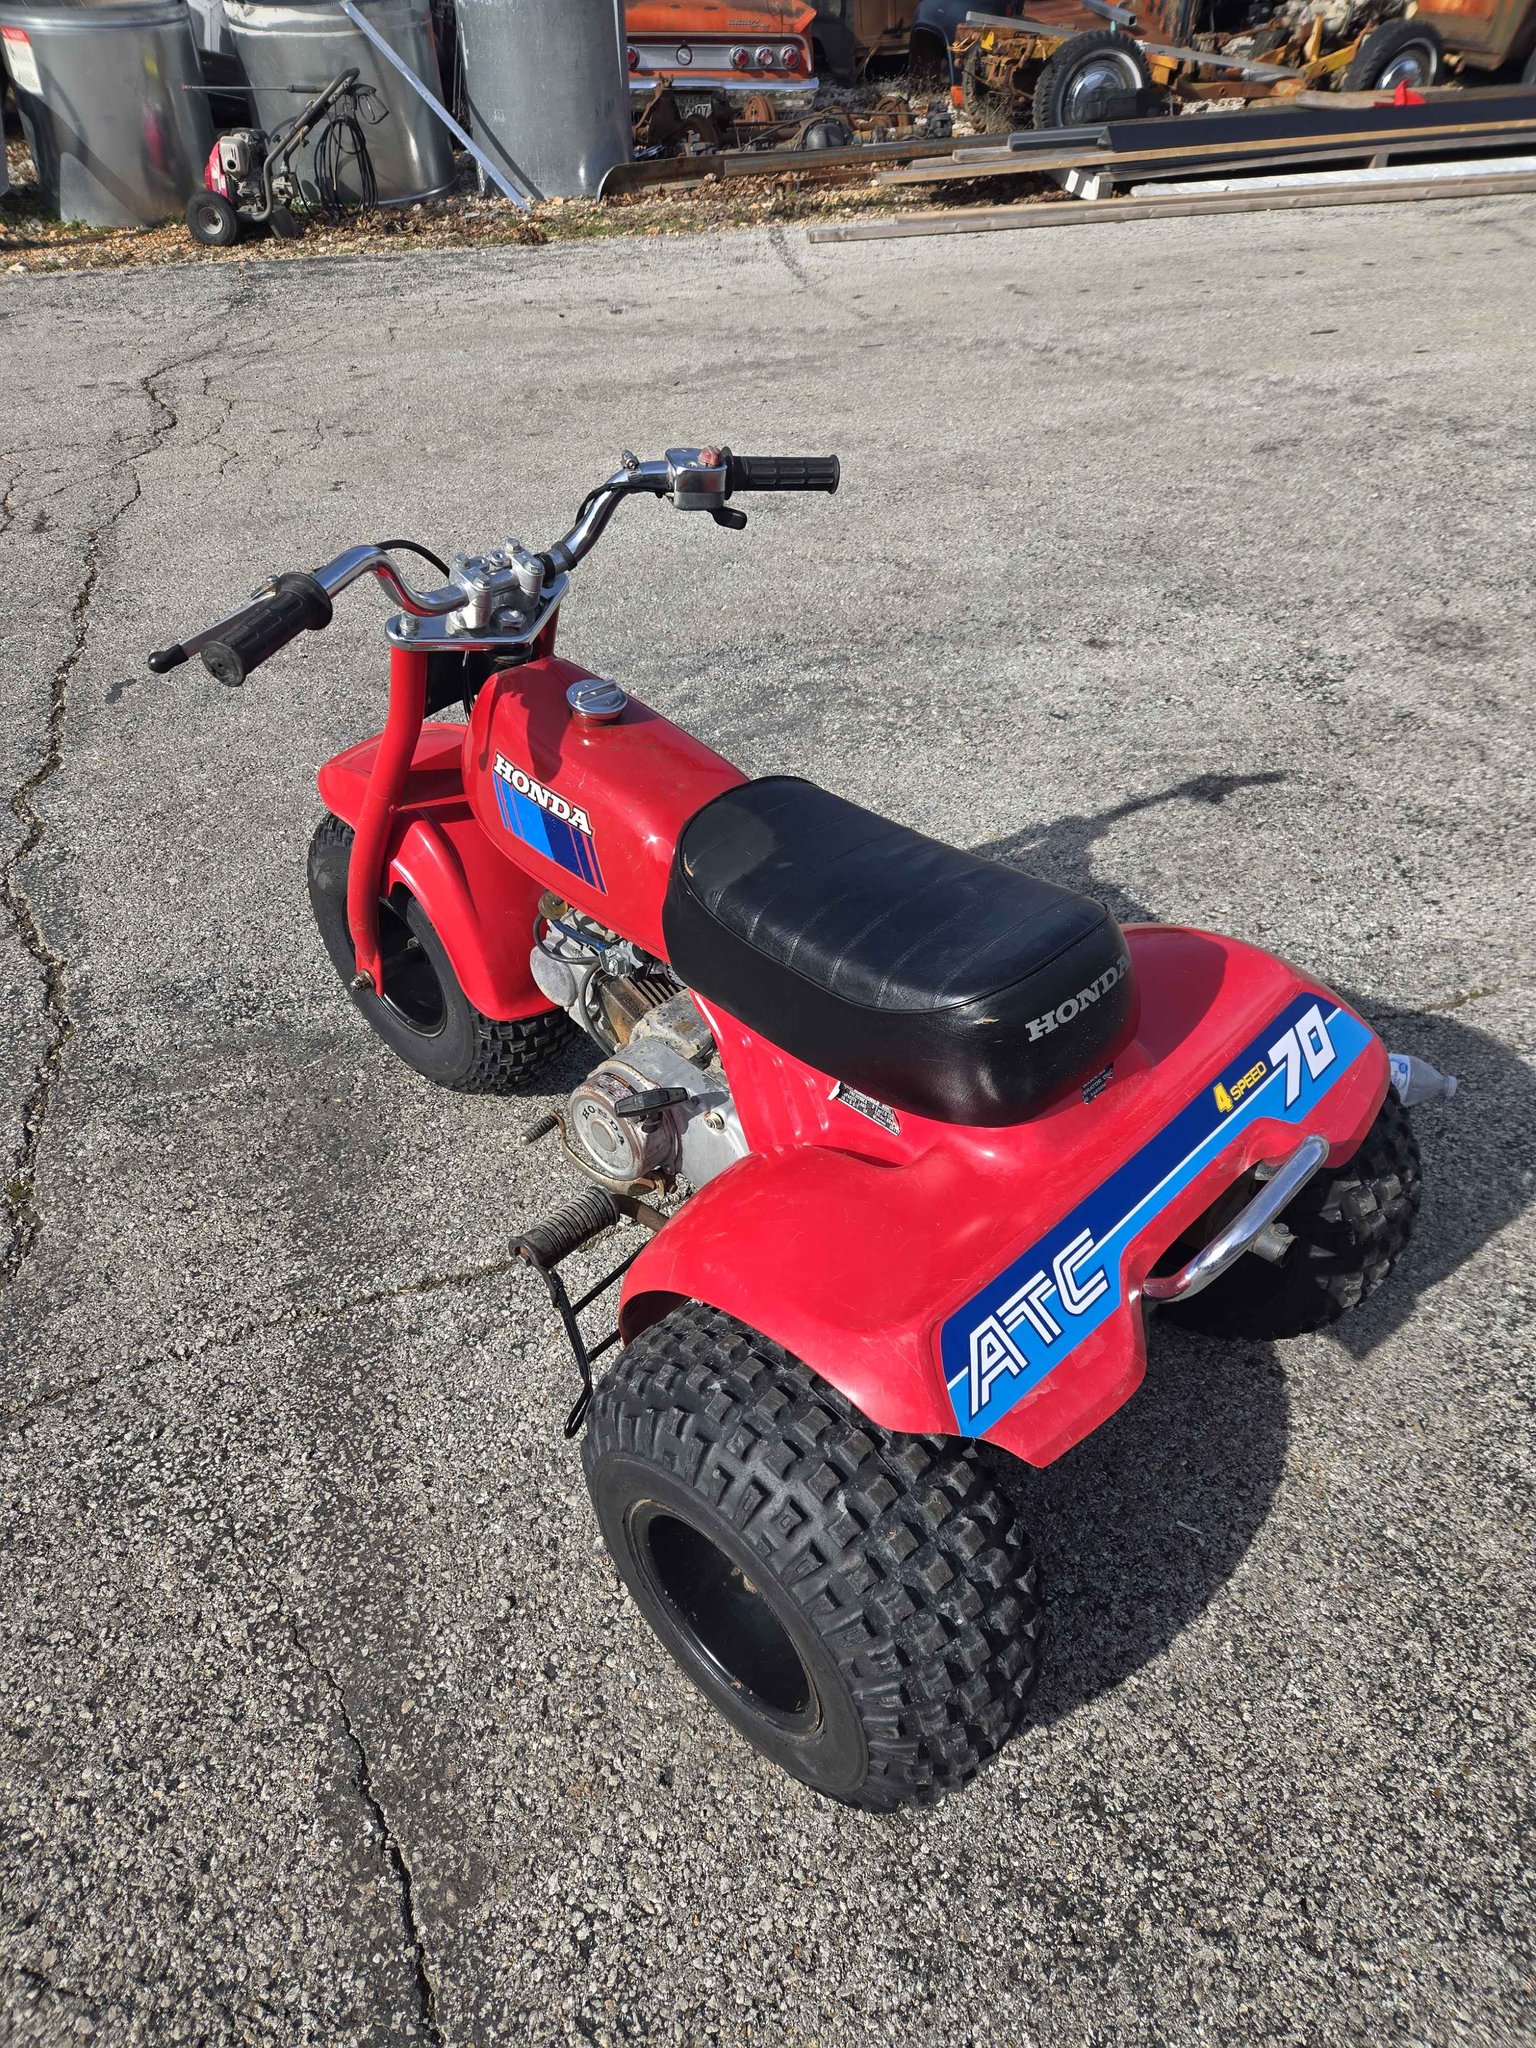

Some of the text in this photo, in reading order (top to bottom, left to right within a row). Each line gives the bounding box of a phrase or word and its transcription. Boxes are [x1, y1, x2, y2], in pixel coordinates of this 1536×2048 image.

[493, 752, 593, 837] HONDA
[1025, 954, 1131, 1043] HONDA
[1213, 1060, 1268, 1113] 4 SPEED
[1268, 1003, 1336, 1109] 70
[969, 1227, 1109, 1417] ATC
